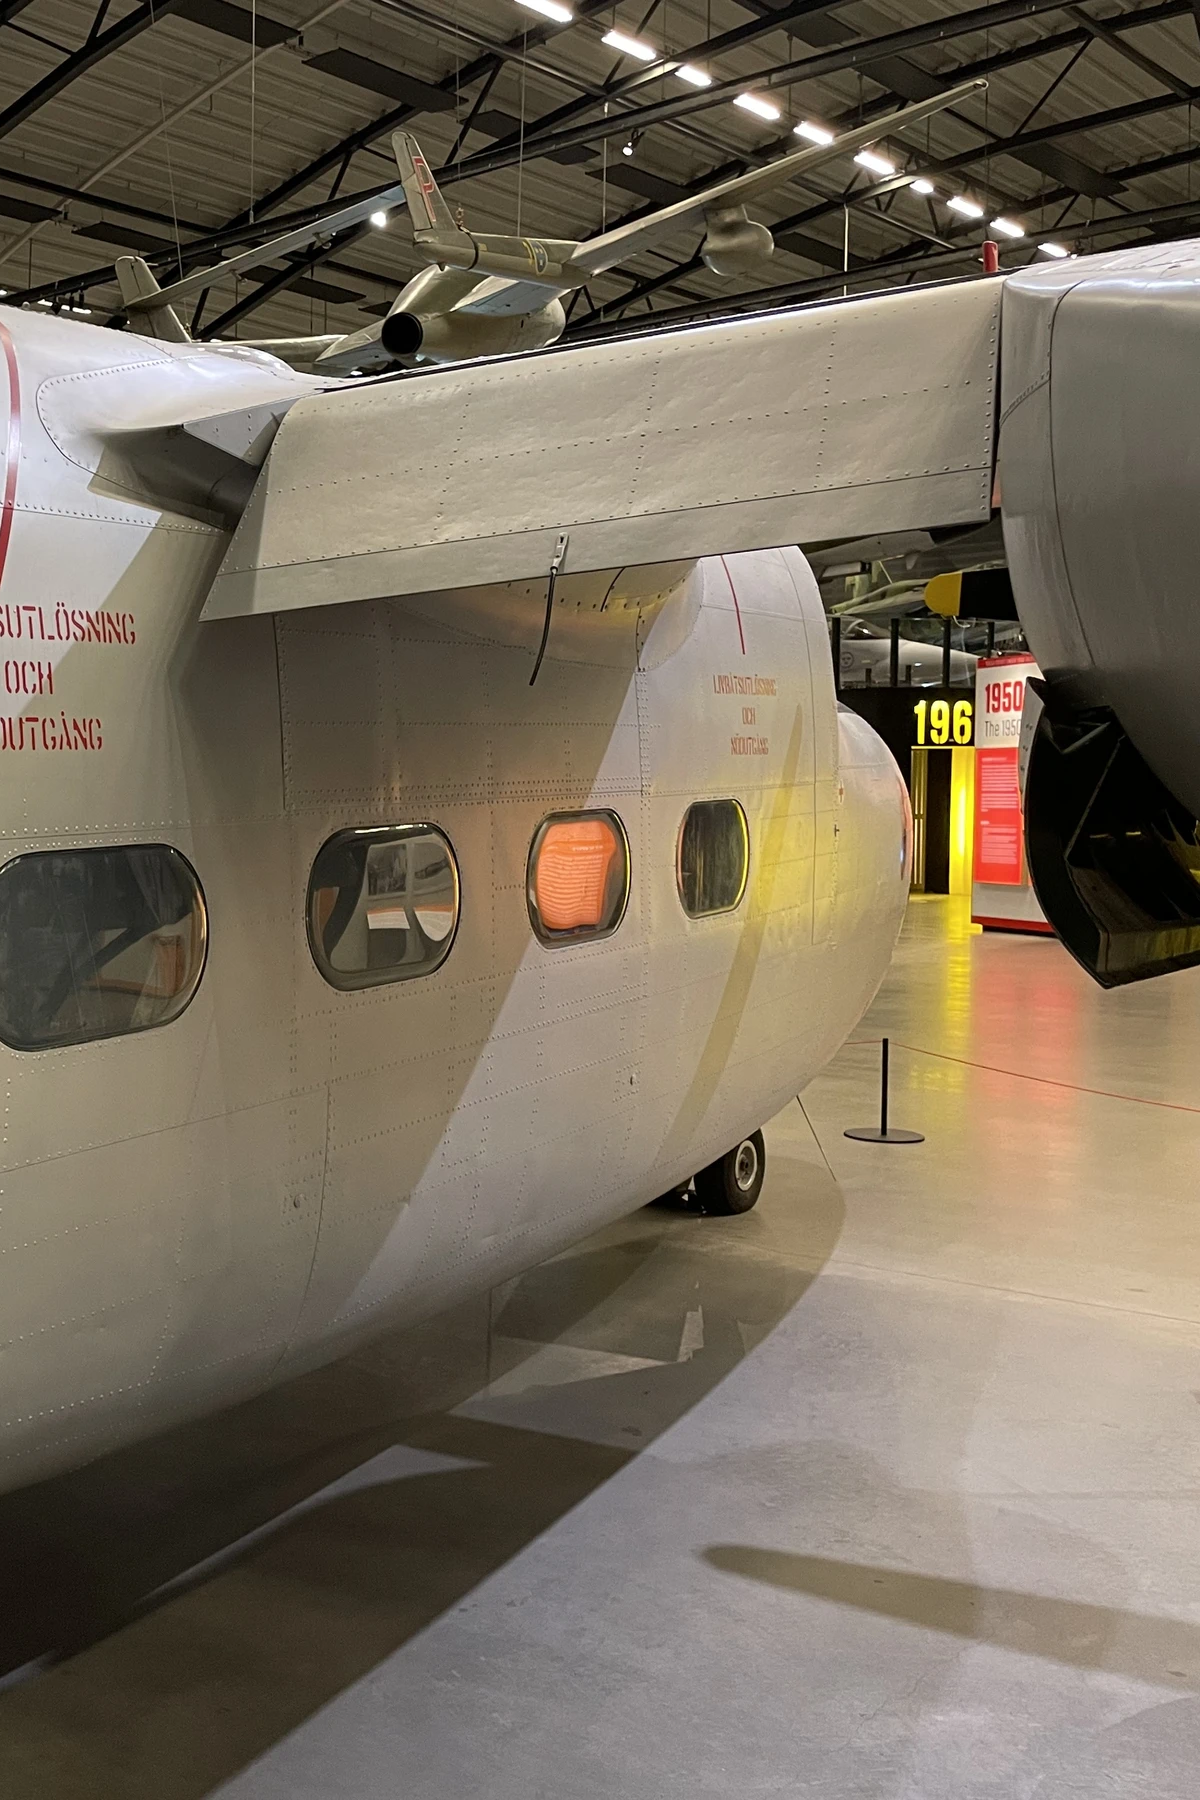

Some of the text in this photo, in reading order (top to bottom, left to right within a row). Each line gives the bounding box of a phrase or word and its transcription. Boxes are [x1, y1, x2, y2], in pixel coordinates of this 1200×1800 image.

[4, 660, 53, 694] OCH
[742, 707, 756, 725] OCH
[985, 721, 1000, 738] The
[731, 733, 769, 755] NÖDUTGÅNG
